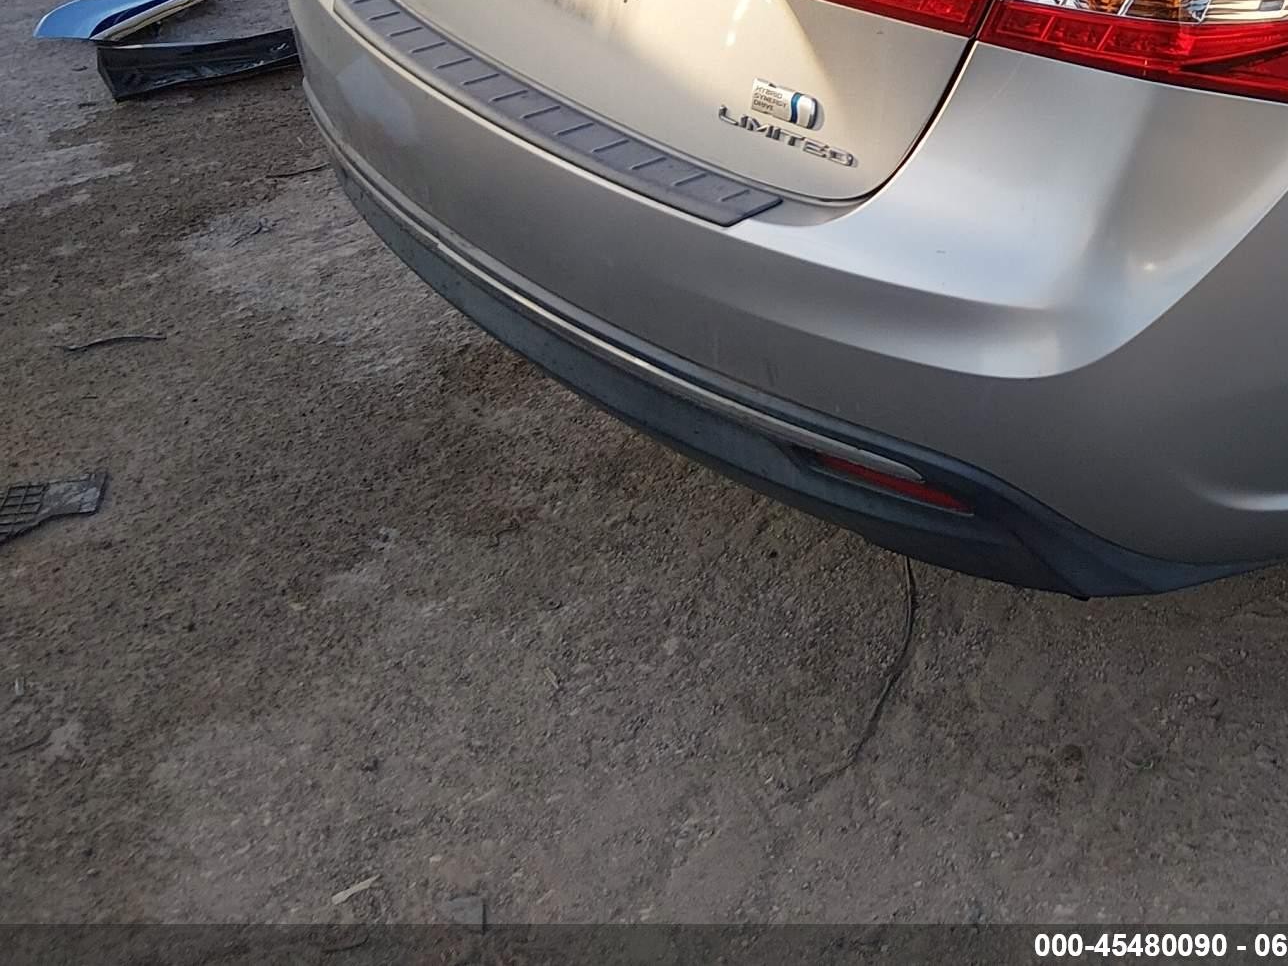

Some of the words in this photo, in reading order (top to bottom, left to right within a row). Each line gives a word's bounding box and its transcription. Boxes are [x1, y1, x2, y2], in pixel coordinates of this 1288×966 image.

[755, 85, 783, 99] HYBRID
[753, 92, 787, 108] SYNERGY
[753, 99, 774, 111] DRIVE
[718, 105, 857, 167] LIMITED
